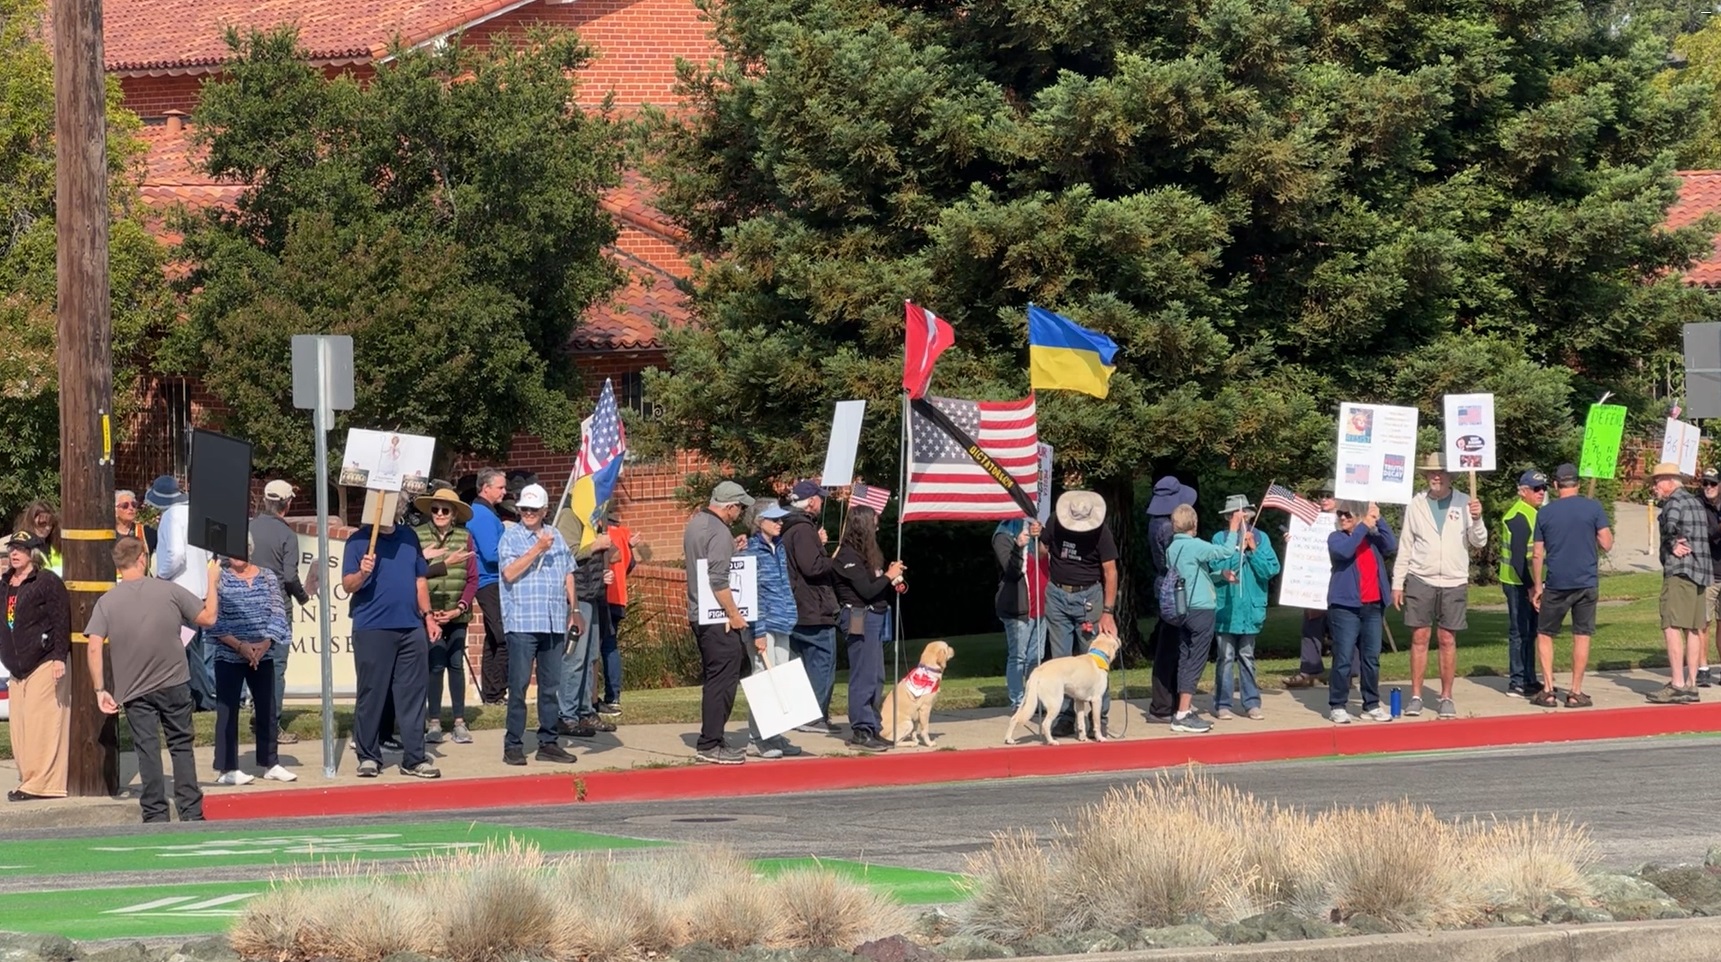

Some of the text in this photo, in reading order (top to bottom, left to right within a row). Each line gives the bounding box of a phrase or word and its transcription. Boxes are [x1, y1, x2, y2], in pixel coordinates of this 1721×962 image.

[1665, 436, 1697, 458] 86 47
[709, 610, 727, 618] FIGH
